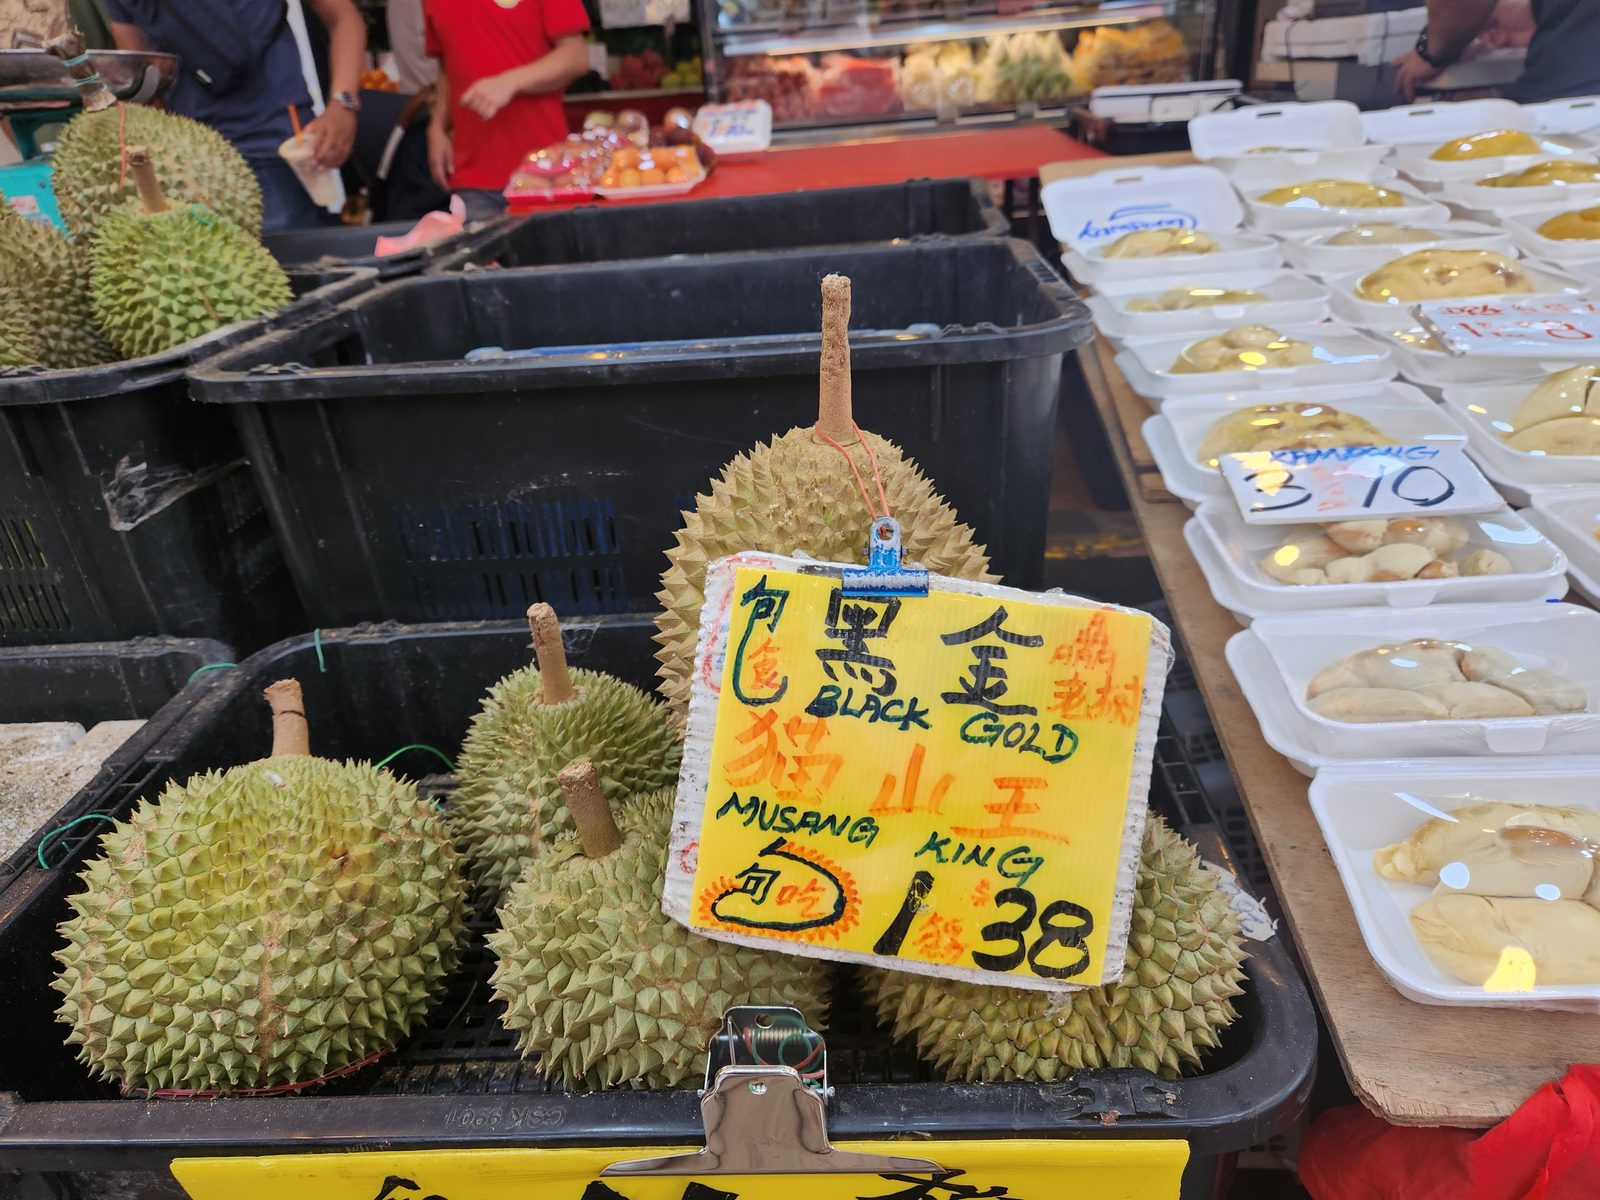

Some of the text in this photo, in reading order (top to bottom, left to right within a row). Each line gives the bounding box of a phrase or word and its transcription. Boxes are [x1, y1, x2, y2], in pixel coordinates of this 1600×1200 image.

[1243, 469, 1313, 513] 3
[1362, 465, 1456, 508] 10
[804, 685, 1079, 765] BLACK GOLD
[716, 791, 1045, 887] MUSANG KING
